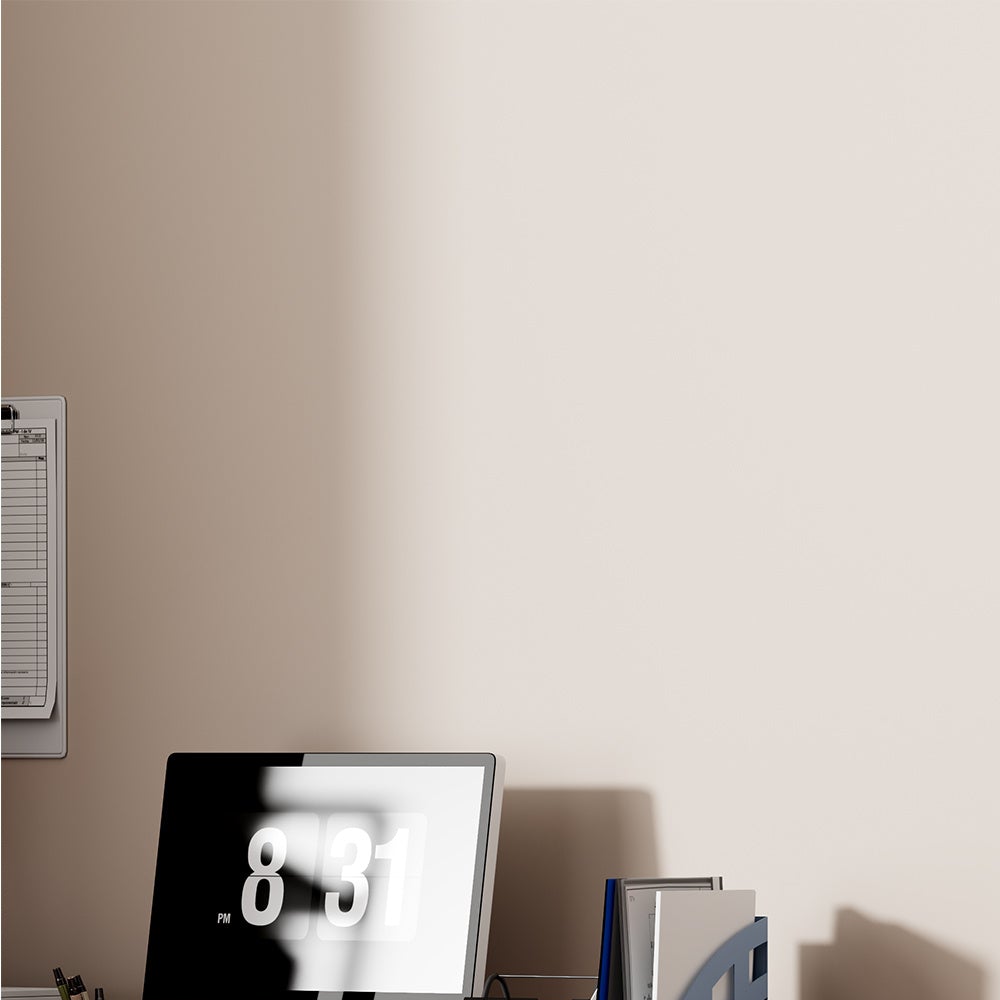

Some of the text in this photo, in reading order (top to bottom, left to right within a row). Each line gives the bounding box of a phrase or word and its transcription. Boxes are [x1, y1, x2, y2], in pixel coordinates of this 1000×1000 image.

[217, 827, 410, 928] PM 8 31
